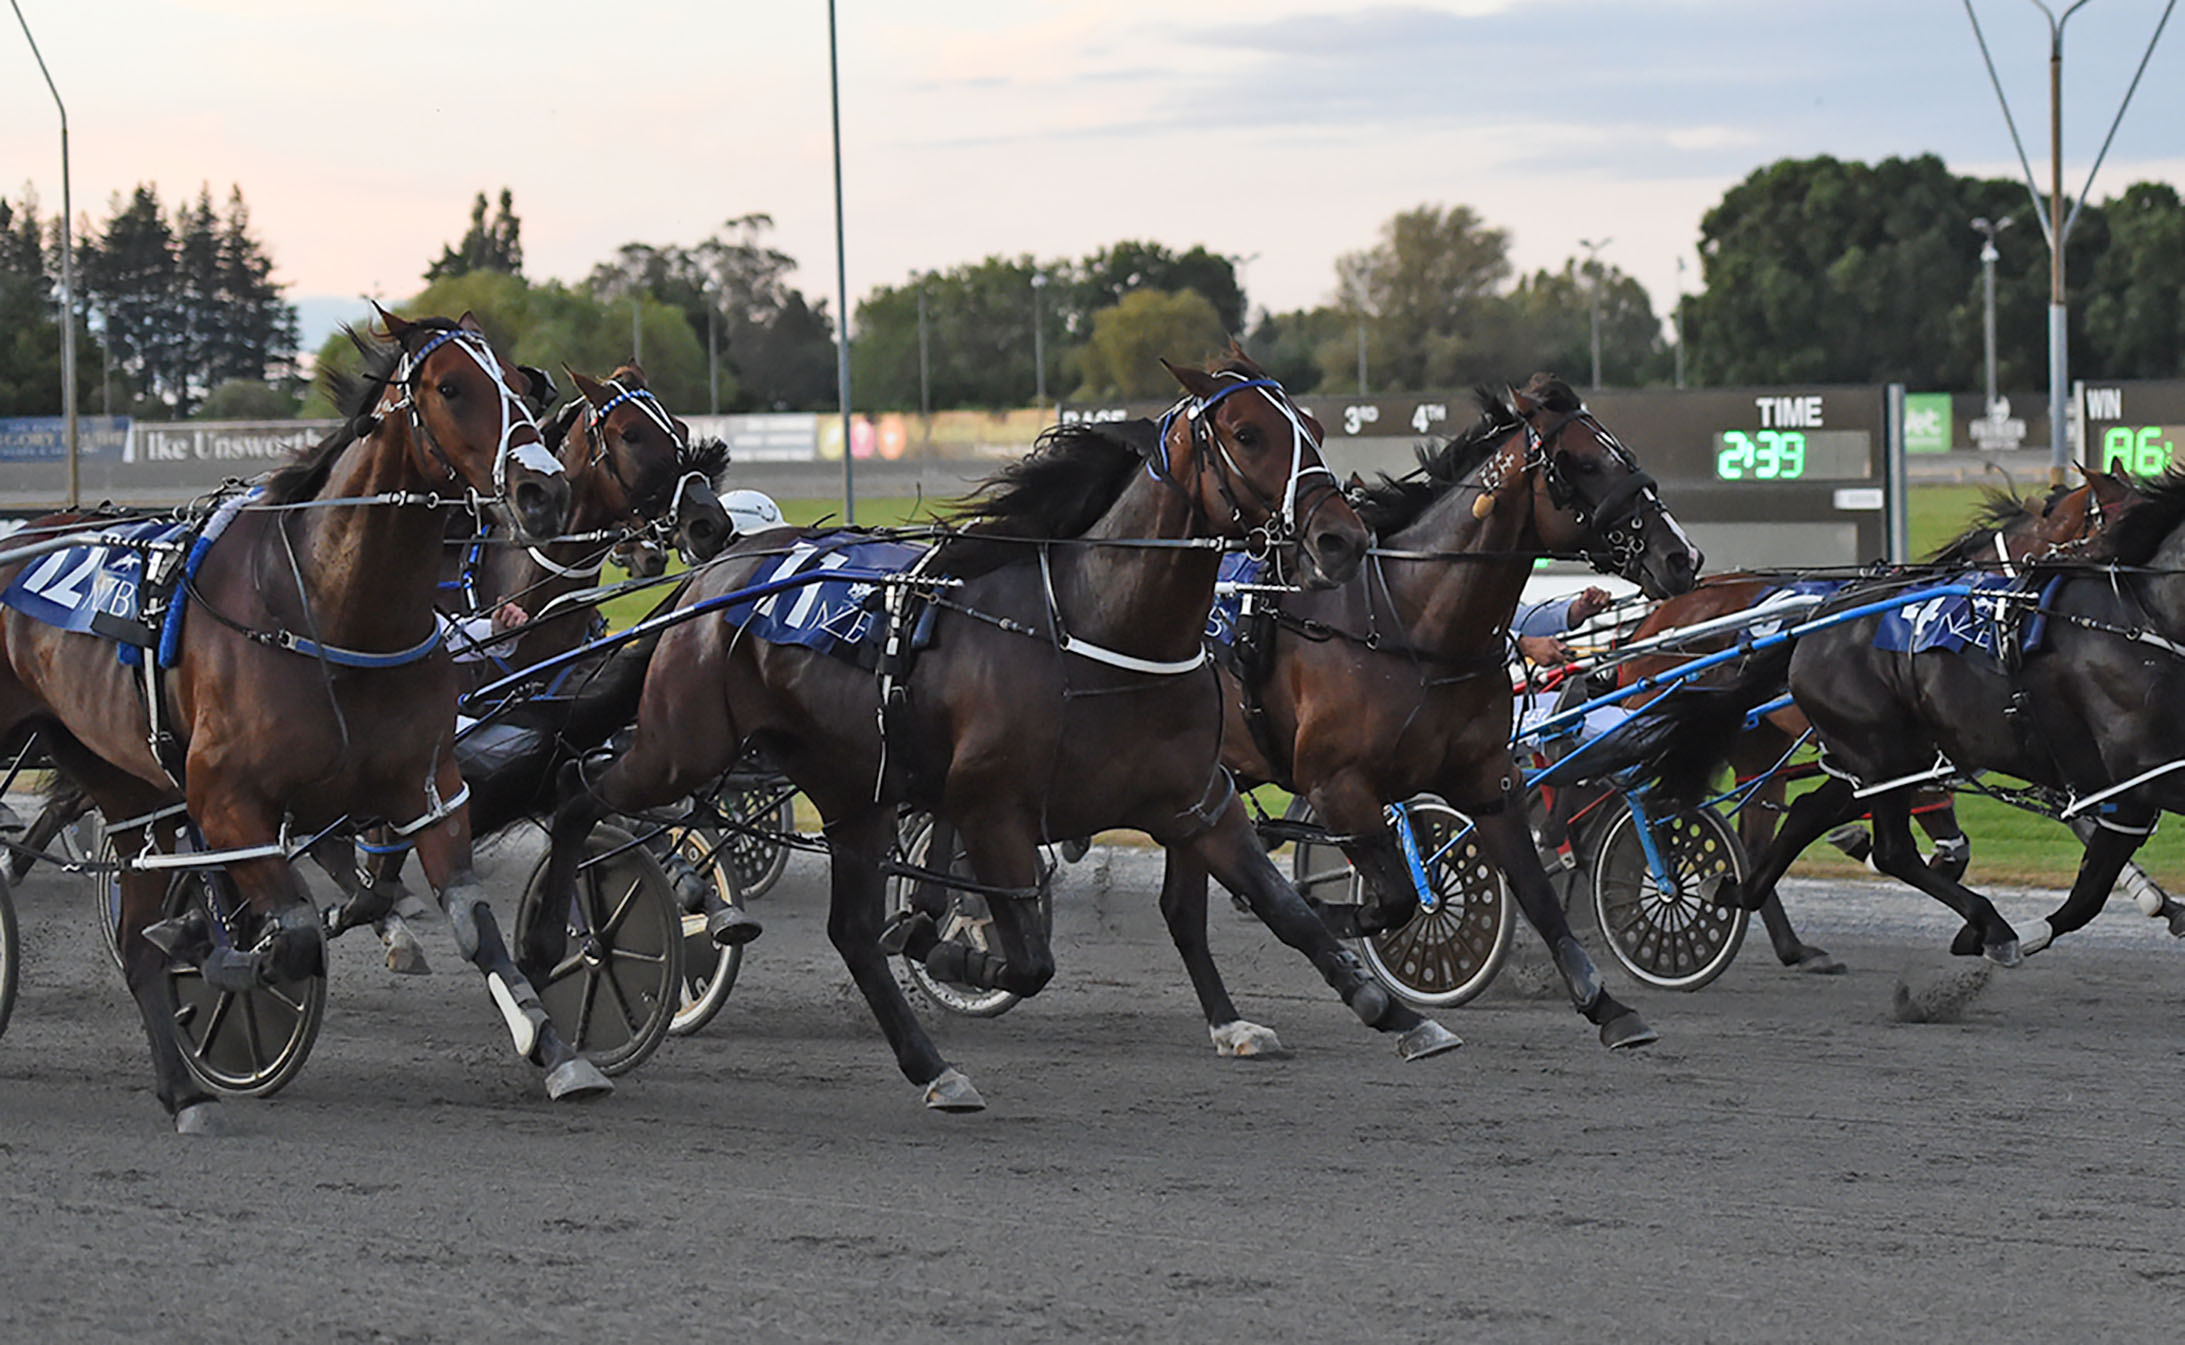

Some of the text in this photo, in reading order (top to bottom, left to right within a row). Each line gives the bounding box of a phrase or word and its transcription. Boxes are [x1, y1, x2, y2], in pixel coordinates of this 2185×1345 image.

[1755, 396, 1824, 428] TIME
[2086, 389, 2121, 420] WIN
[149, 431, 188, 460] Ike
[1718, 430, 1806, 480] 2:39
